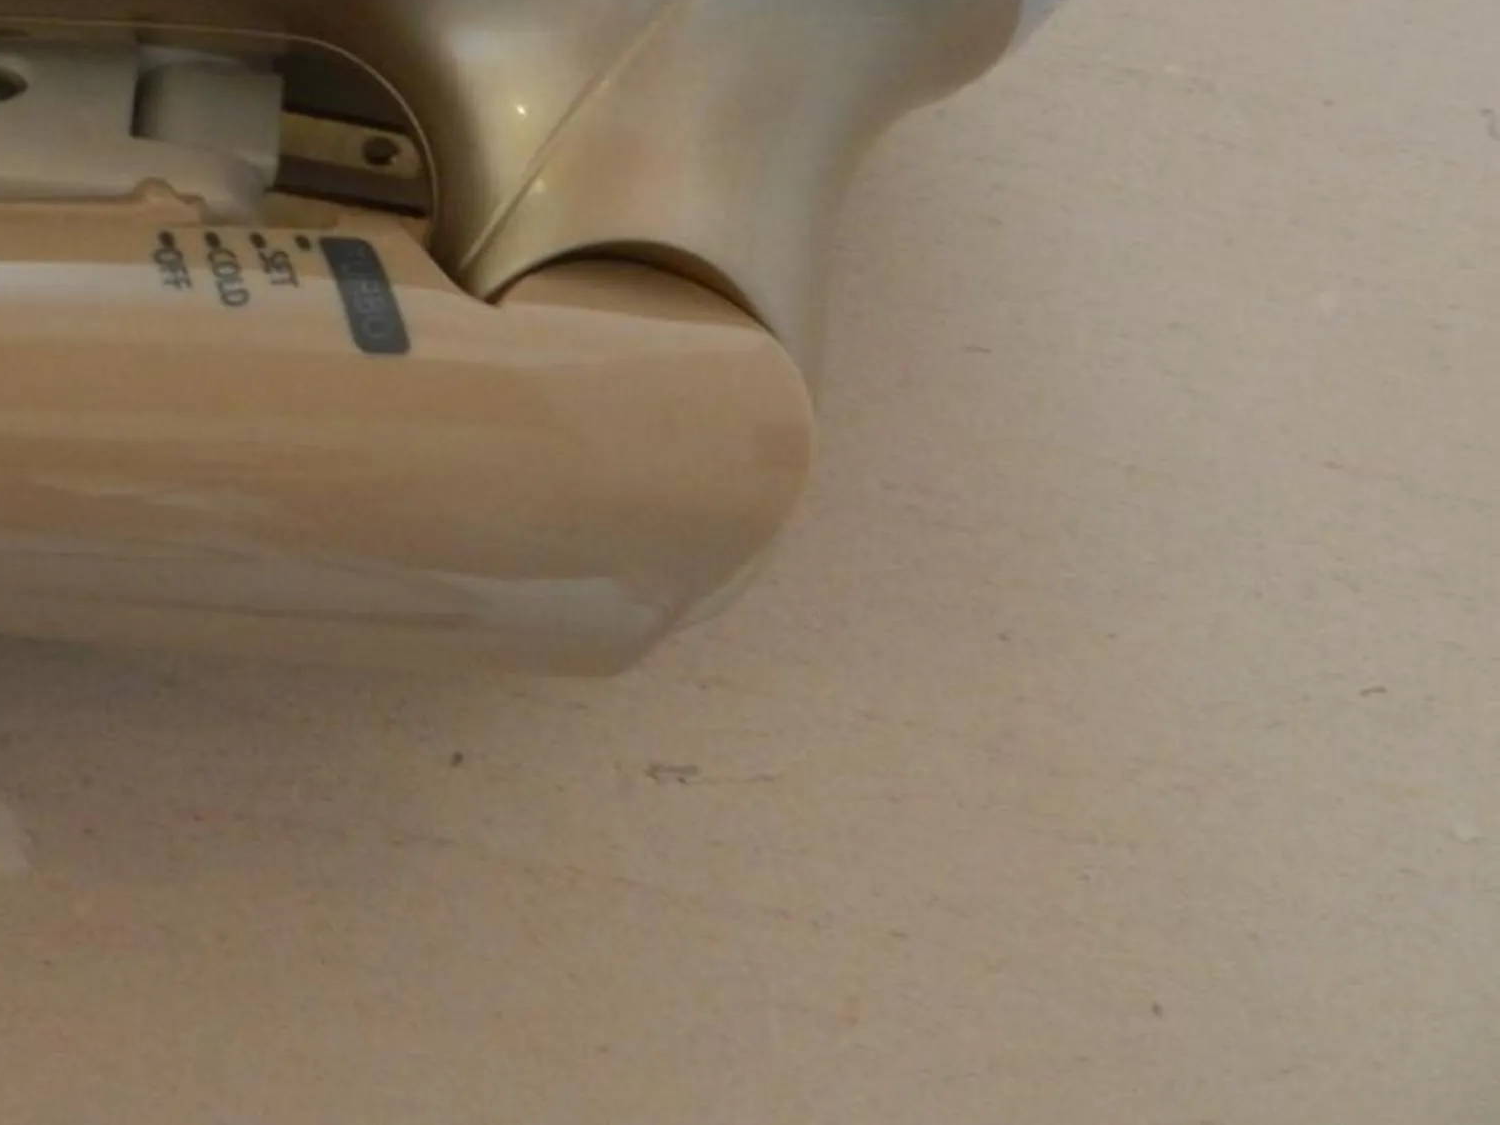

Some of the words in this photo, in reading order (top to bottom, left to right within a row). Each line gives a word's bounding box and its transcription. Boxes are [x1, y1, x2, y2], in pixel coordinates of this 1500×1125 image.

[153, 247, 192, 290] OFF
[207, 248, 250, 307] COLD
[259, 249, 299, 287] SET
